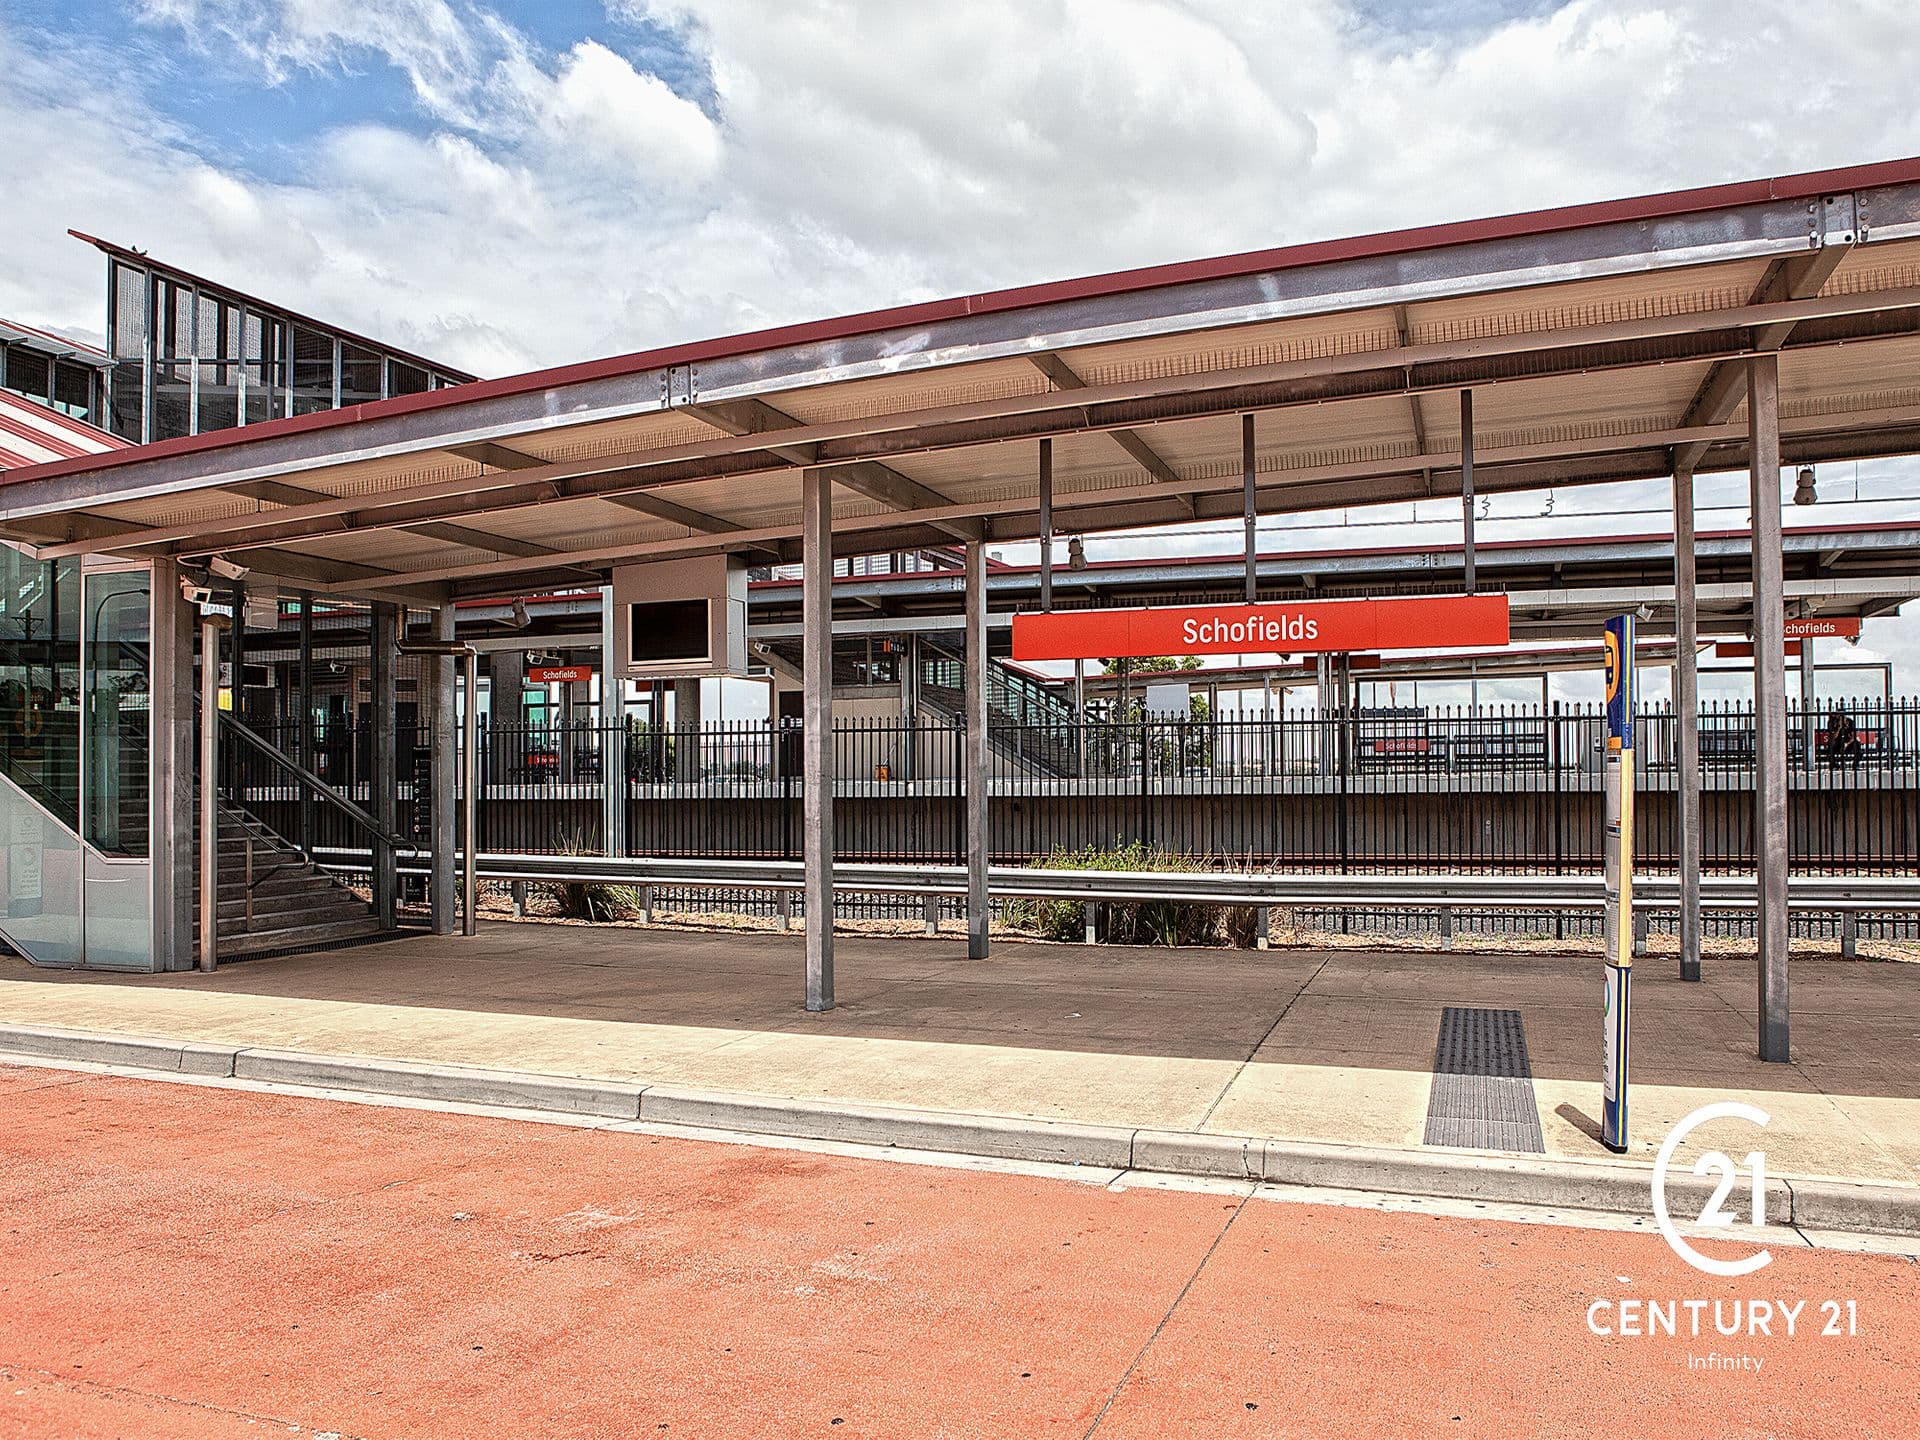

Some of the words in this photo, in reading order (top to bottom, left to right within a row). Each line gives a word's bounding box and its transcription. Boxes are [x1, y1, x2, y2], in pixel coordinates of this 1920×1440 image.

[1183, 614, 1318, 644] Schofields
[1784, 622, 1836, 634] chofields
[543, 671, 577, 680] Schofields
